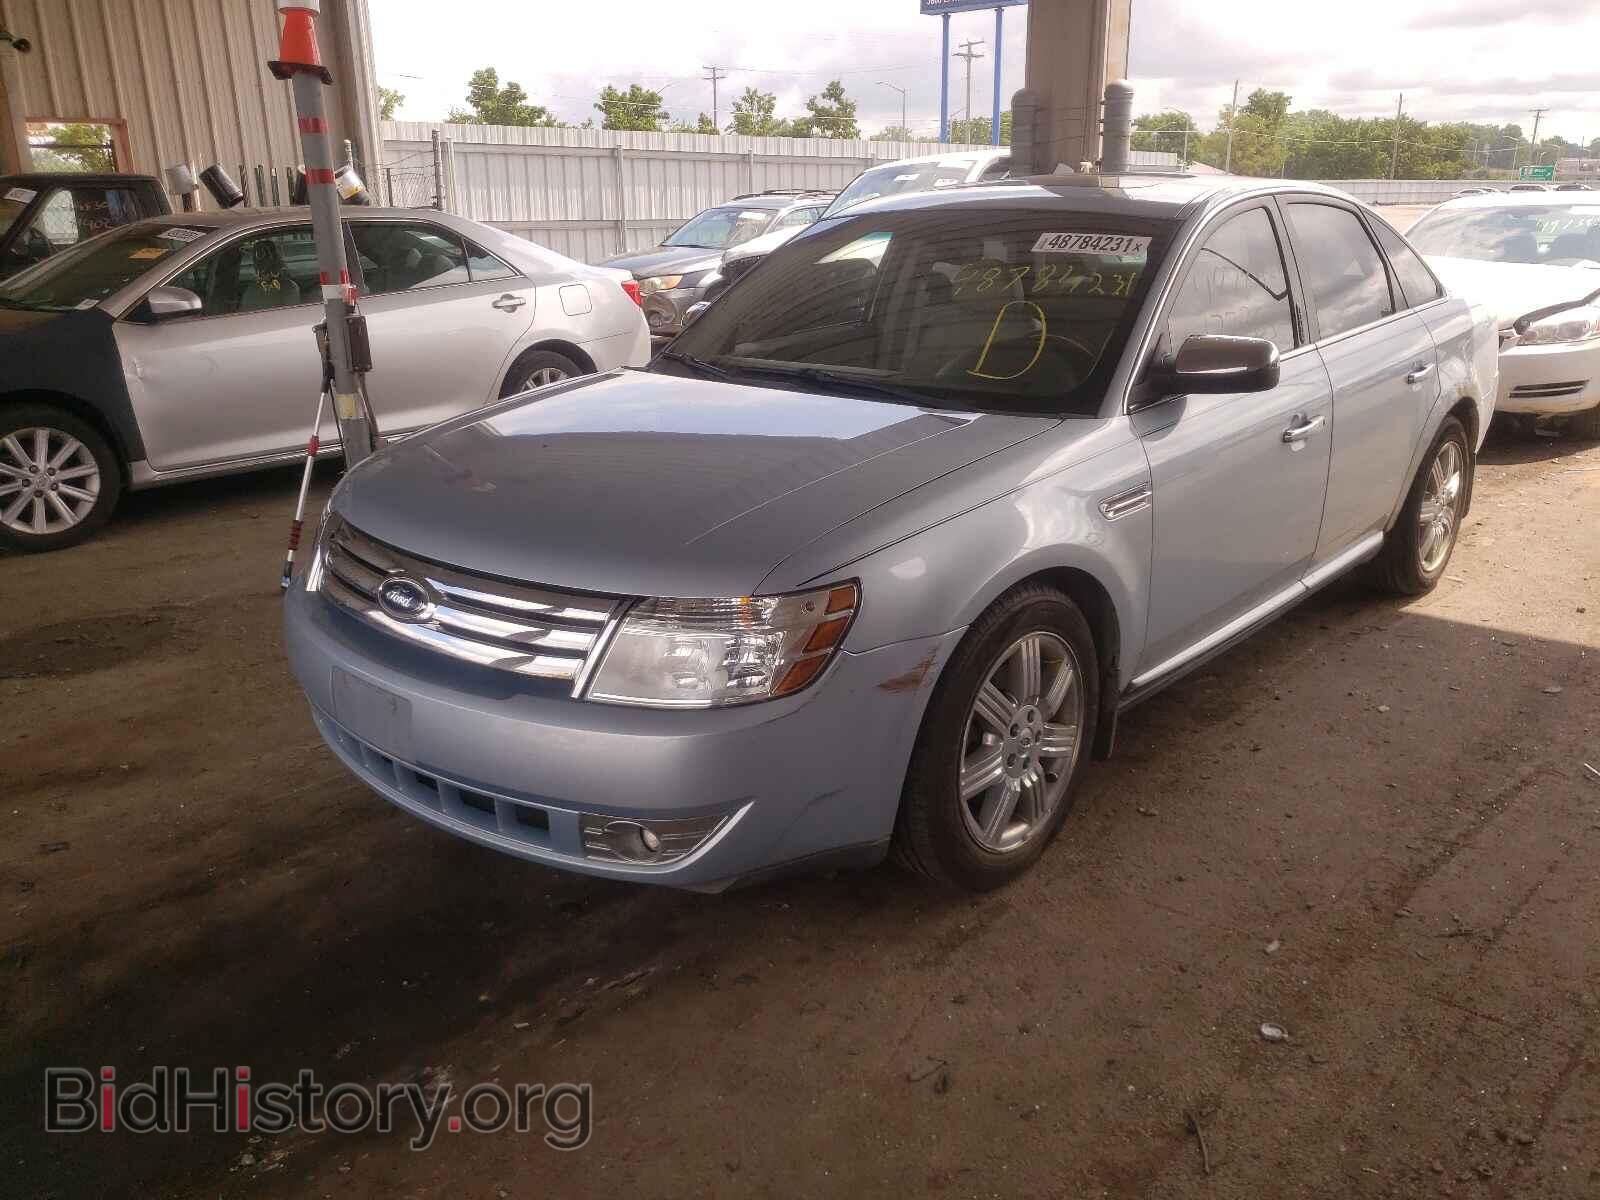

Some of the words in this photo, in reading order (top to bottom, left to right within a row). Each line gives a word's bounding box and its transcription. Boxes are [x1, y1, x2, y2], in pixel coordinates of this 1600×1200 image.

[1047, 234, 1133, 253] 48784231
[966, 300, 1047, 380] D
[386, 590, 413, 608] Ford
